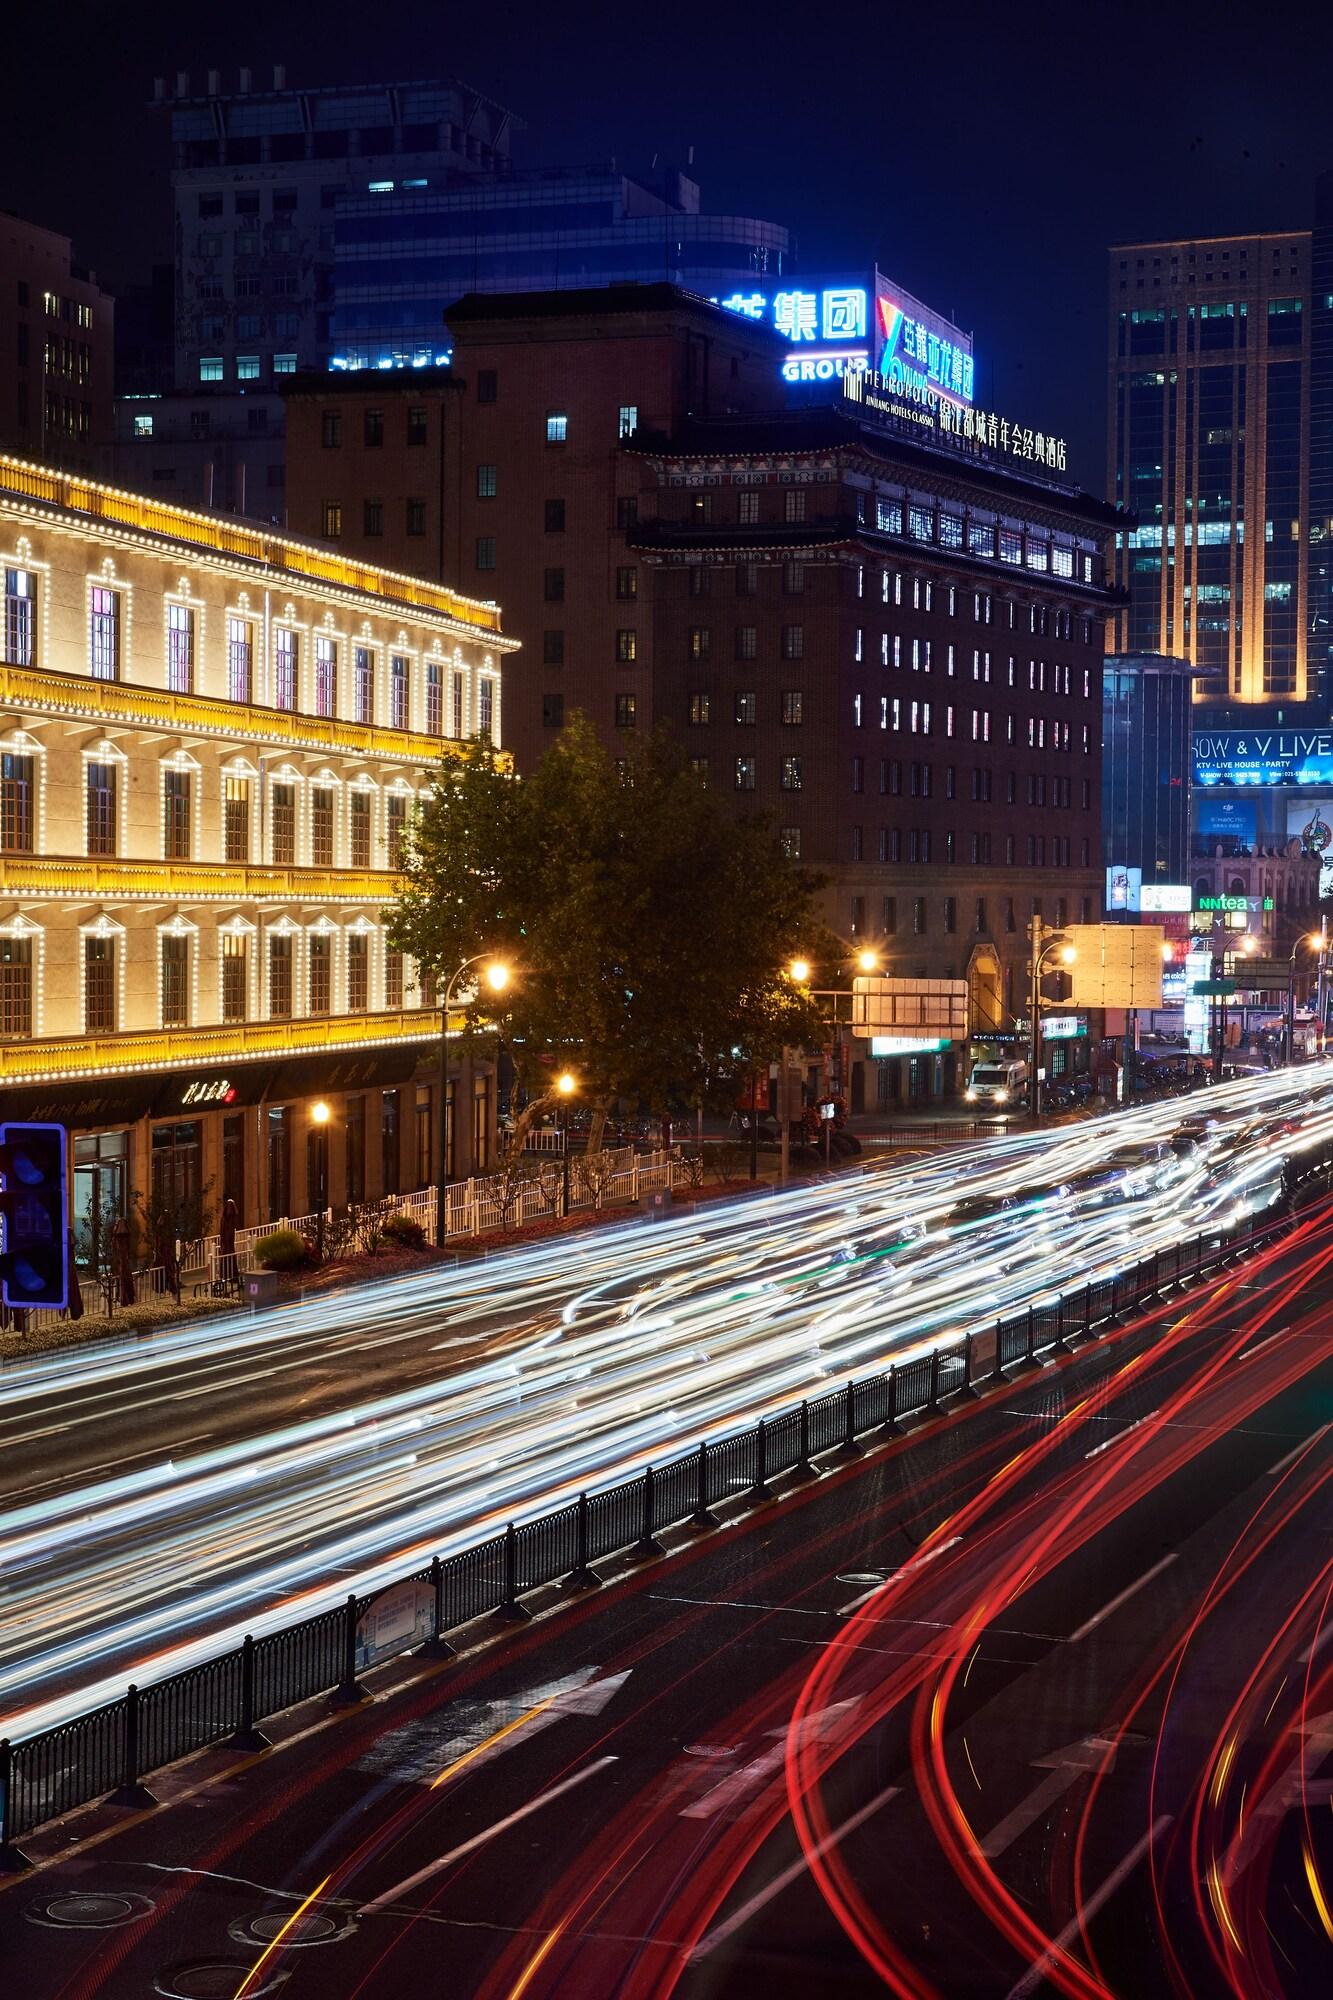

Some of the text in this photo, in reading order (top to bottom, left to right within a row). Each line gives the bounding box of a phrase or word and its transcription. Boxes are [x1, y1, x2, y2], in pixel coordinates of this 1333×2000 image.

[709, 289, 867, 342] 龙集团
[890, 404, 912, 420] HOTELS
[939, 397, 1067, 472] 锦江都城青年会经典酒店
[1236, 740, 1248, 755] &
[1254, 736, 1272, 757] V
[1279, 735, 1332, 757] LIVE
[1265, 760, 1291, 768] PARTY
[1199, 893, 1248, 910] NNtea
